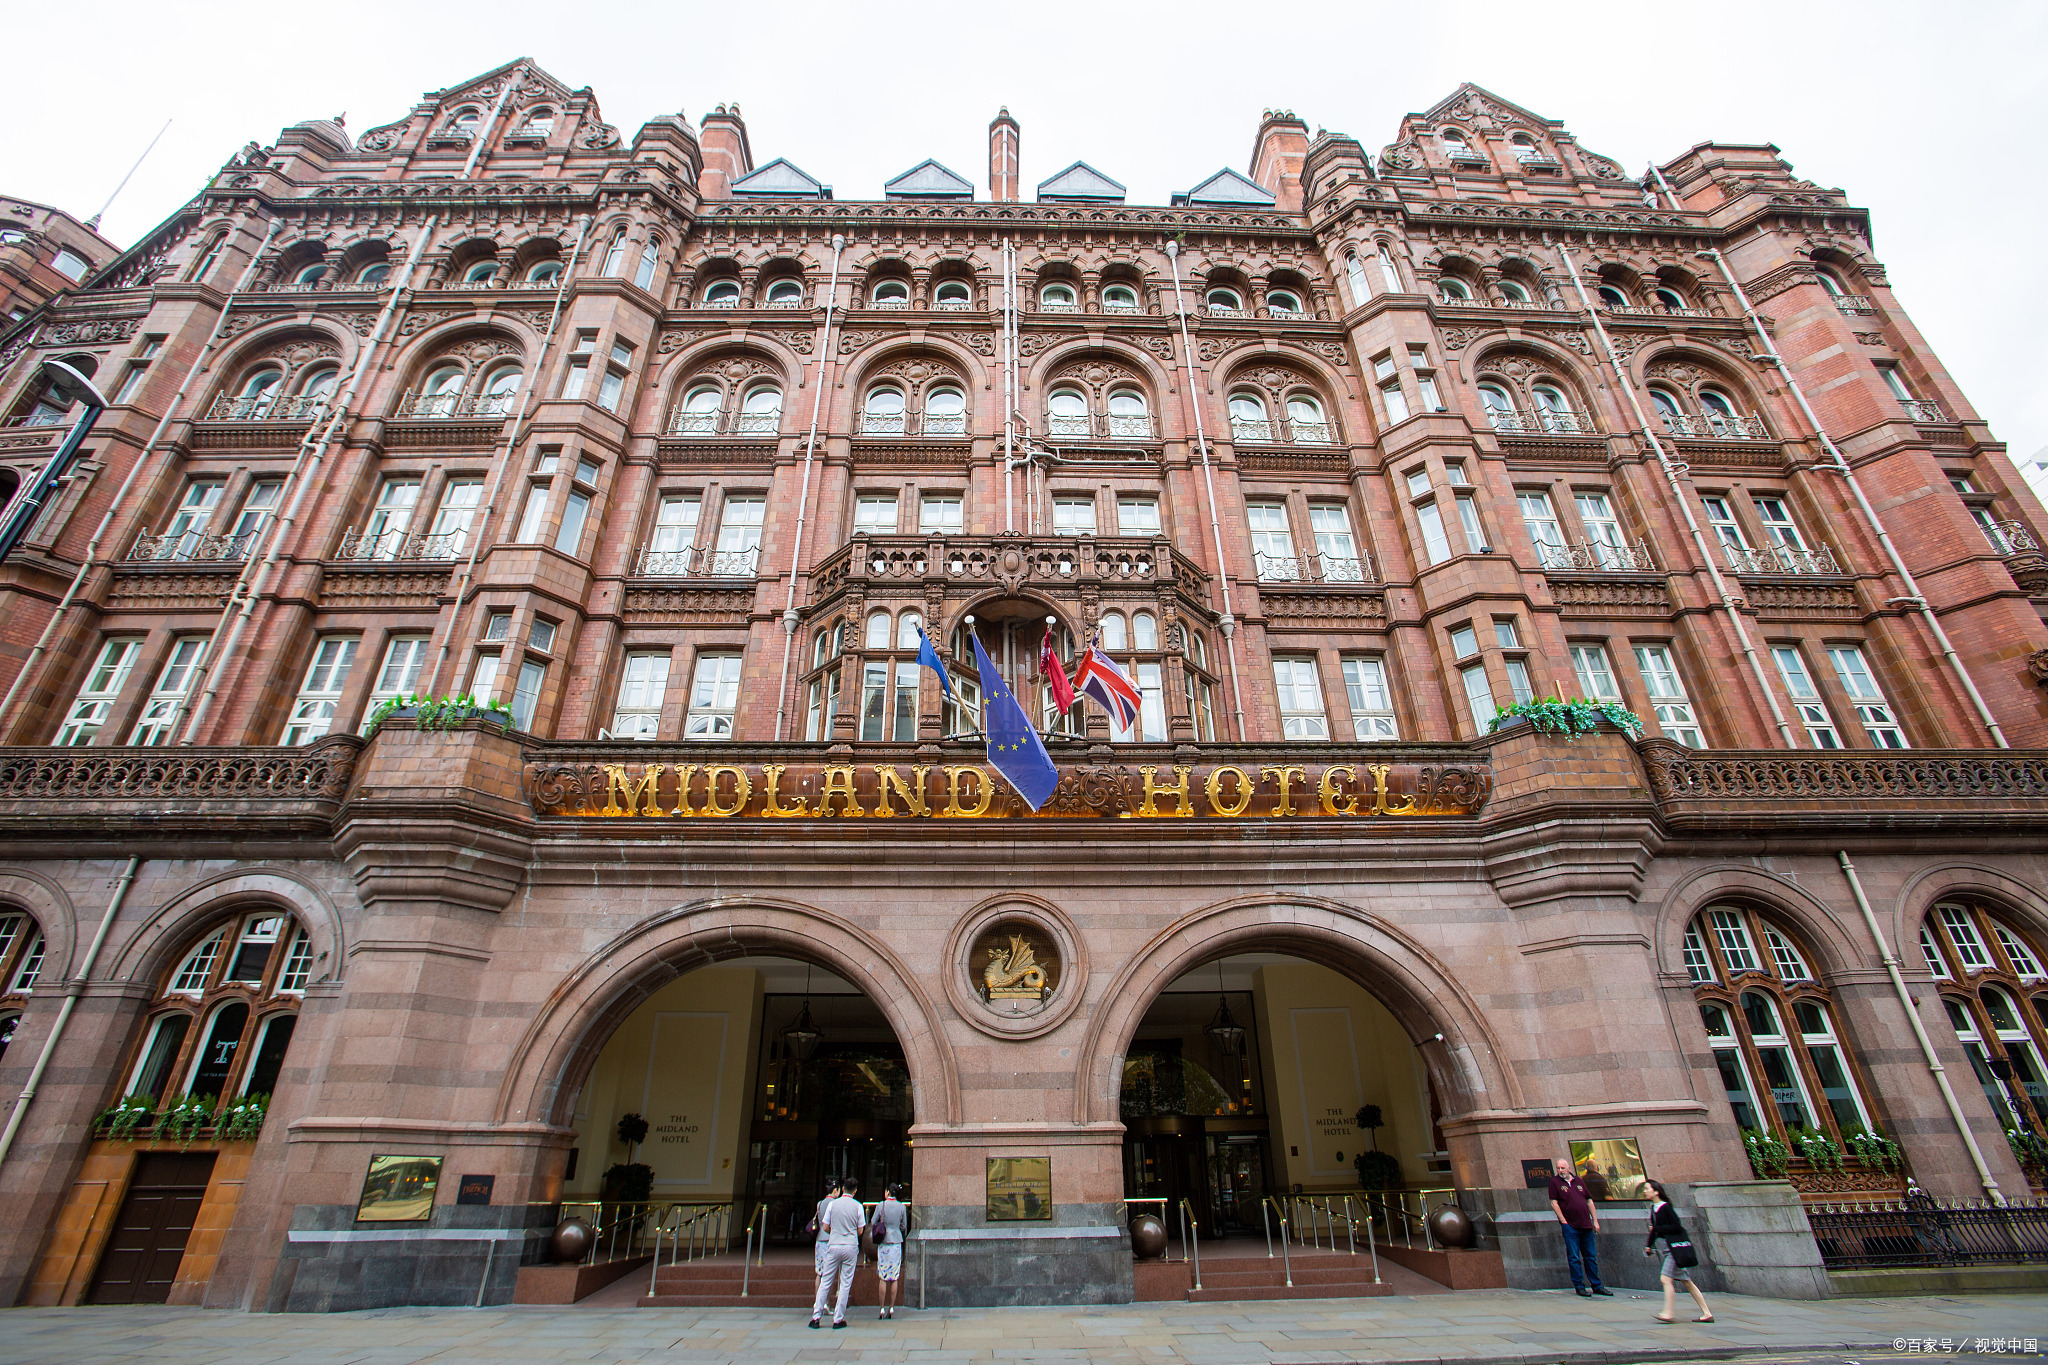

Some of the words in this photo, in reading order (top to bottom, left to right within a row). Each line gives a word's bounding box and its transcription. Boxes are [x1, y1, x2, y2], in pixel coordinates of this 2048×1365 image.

[602, 763, 996, 818] MIDLAND
[1137, 763, 1417, 818] HOTEL
[213, 1040, 239, 1064] T
[1325, 1108, 1343, 1116] THE
[670, 1115, 688, 1123] THE
[1315, 1117, 1357, 1127] MIDLAND
[655, 1125, 699, 1133] MIDLAND
[1323, 1128, 1352, 1136] HOTEL
[661, 1135, 690, 1144] HOTEL
